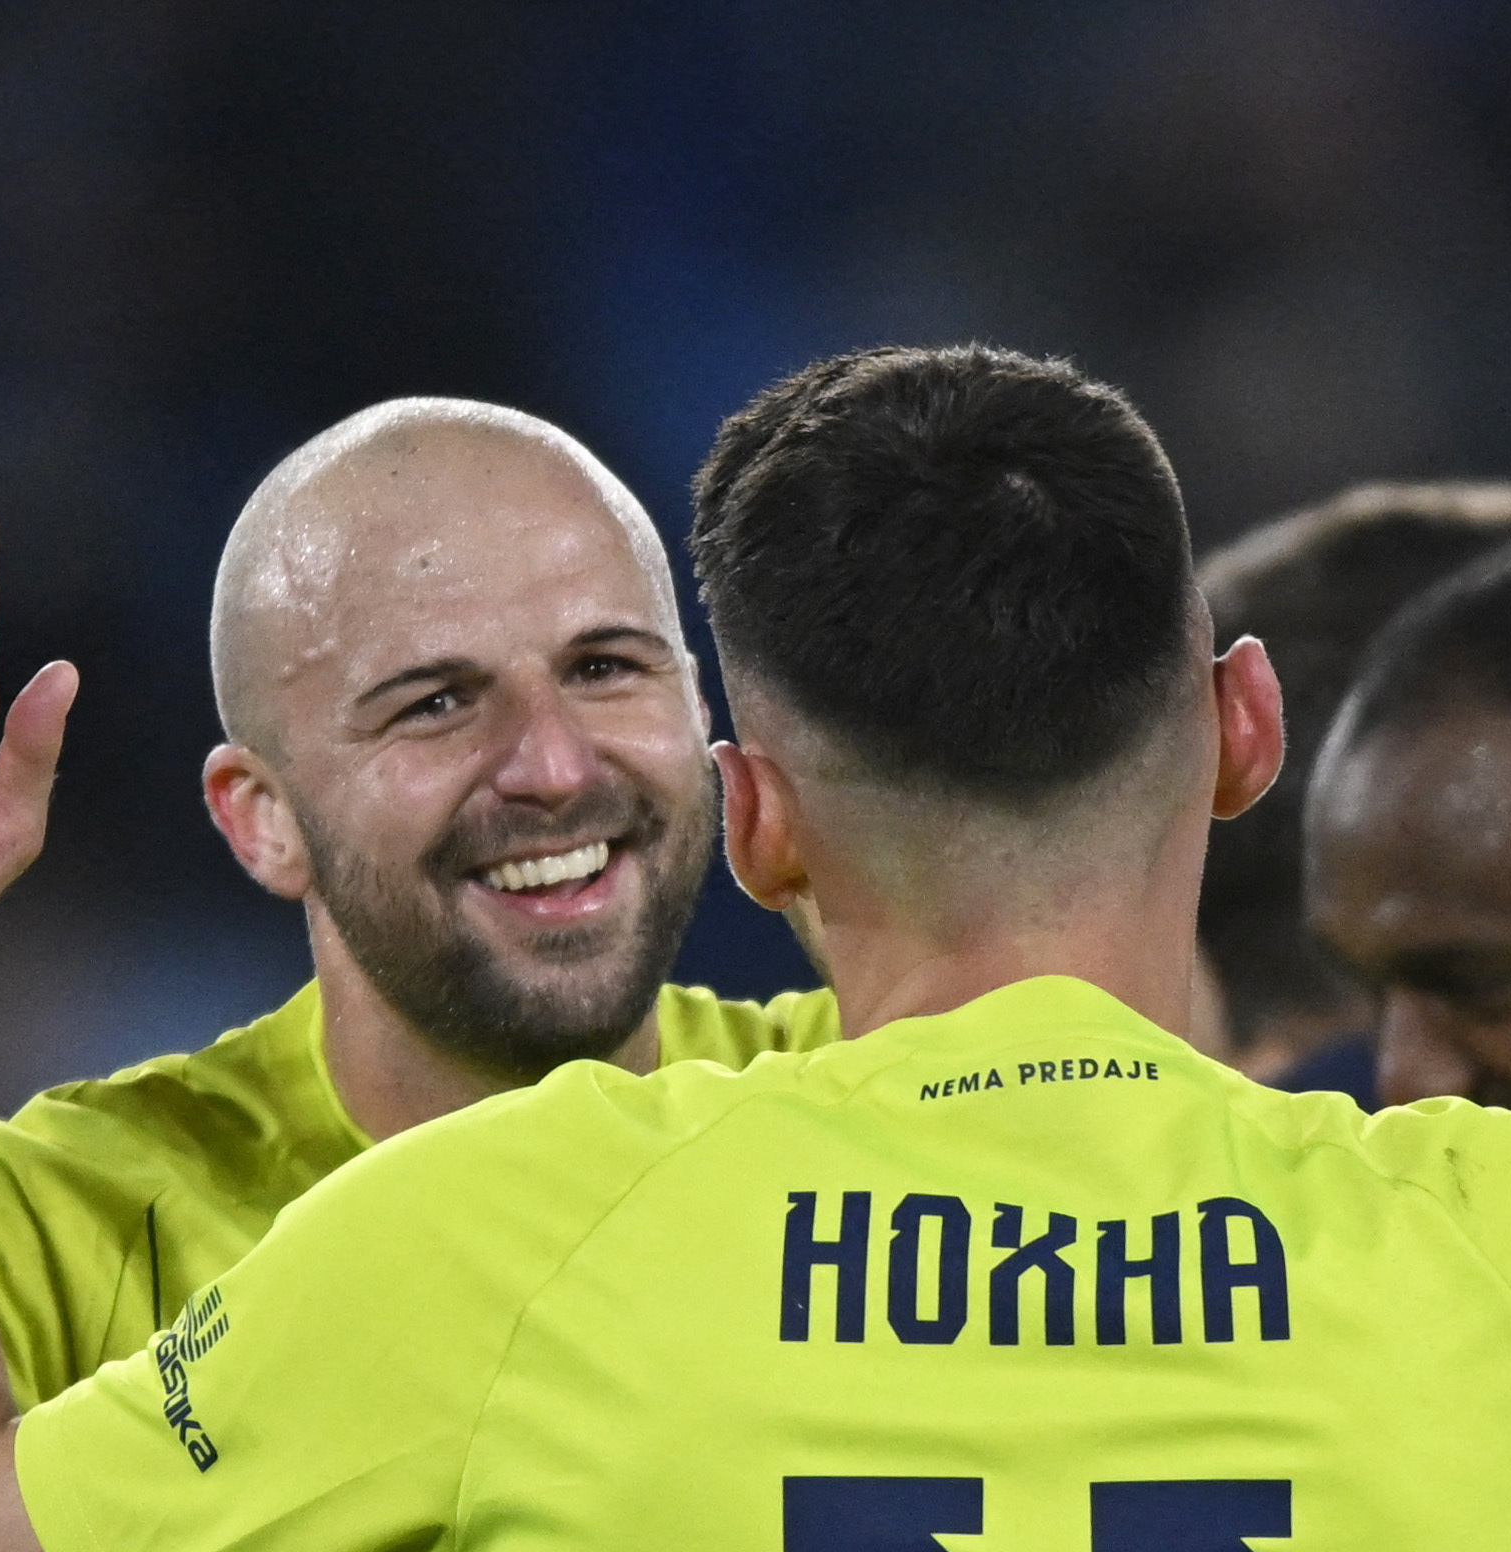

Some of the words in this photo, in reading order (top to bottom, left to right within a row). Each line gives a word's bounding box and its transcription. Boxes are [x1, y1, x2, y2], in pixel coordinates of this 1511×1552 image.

[920, 1068, 1004, 1101] NEMA
[1017, 1058, 1159, 1086] PREDAJE
[779, 1190, 1290, 1346] HOXHA
